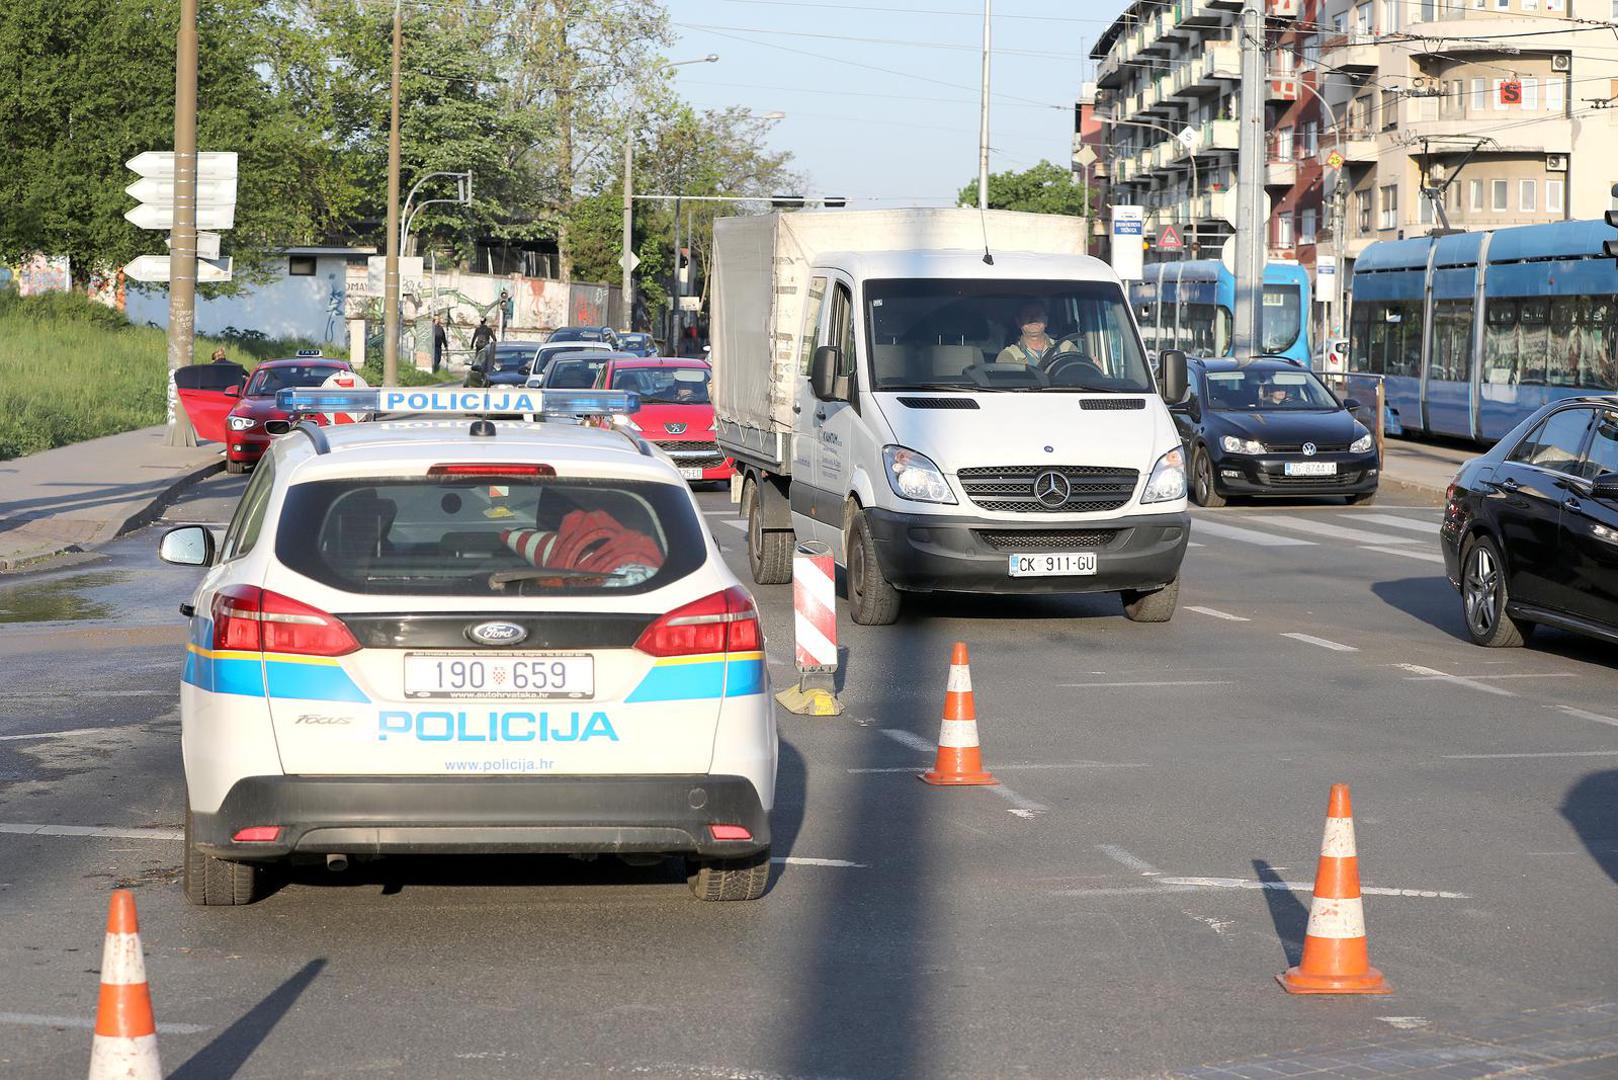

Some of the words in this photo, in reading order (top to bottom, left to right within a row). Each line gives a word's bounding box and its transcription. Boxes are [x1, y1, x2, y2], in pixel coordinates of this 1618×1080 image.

[1504, 83, 1519, 102] S
[1331, 154, 1341, 166] 25
[387, 393, 534, 411] POLICIJA
[1020, 558, 1035, 572] CK
[1046, 556, 1094, 571] 911-GU
[483, 624, 514, 639] Ford
[437, 661, 485, 688] 190
[513, 661, 566, 689] 659
[379, 711, 619, 742] POLICIJA
[445, 758, 554, 772] www.policija.hr
